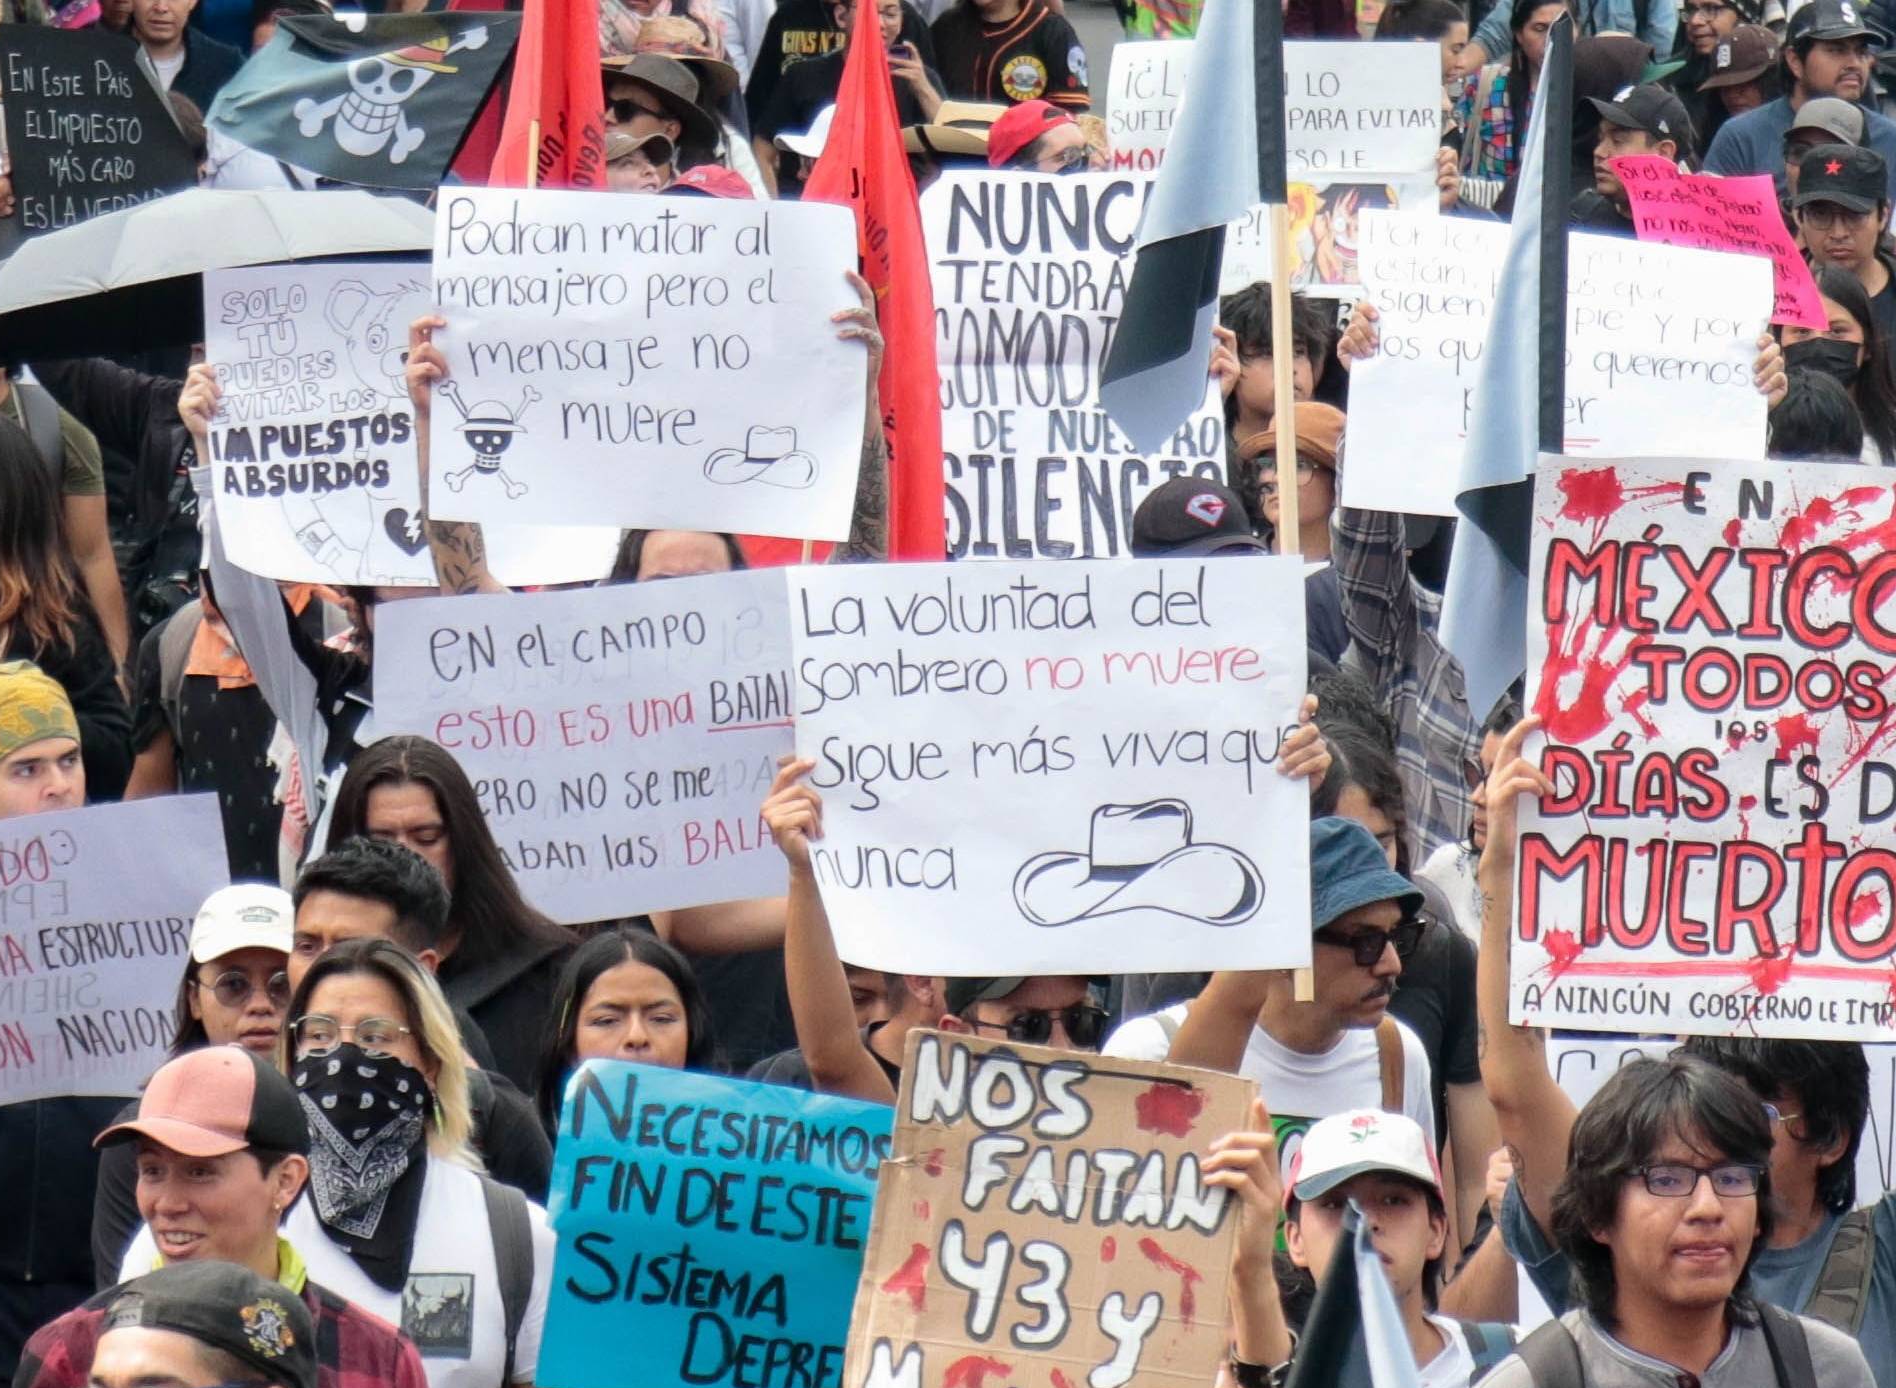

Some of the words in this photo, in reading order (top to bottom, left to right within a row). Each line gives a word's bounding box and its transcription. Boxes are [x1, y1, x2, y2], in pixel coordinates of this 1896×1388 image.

[8, 53, 35, 93] EN
[42, 66, 84, 97] ESTE
[1306, 71, 1340, 97] LO
[1289, 109, 1349, 131] PARA
[1357, 107, 1437, 130] EVITAR
[49, 148, 85, 187] MÁS
[91, 156, 135, 183] CARO
[23, 197, 47, 228] ES
[50, 194, 76, 228] LA
[447, 196, 586, 258] Podran
[603, 209, 716, 257] matar
[735, 212, 771, 256] al
[221, 284, 306, 324] SOLO
[436, 268, 628, 317] mensajero
[646, 272, 728, 318] pero
[748, 268, 780, 305] el
[214, 350, 337, 391] PUEDES
[468, 333, 664, 388] mensaje
[693, 333, 751, 371] no
[1594, 350, 1751, 390] queremos
[211, 381, 325, 425] EVITAR
[330, 388, 377, 413] LOS
[562, 401, 705, 447] muere
[211, 412, 410, 463] IMPUESTOS
[974, 410, 1016, 453] DE
[224, 459, 390, 498] ABSURDOS
[802, 586, 866, 638] La
[885, 575, 1097, 635] voluntad
[1131, 566, 1212, 628] del
[1025, 655, 1085, 690] no
[1104, 645, 1266, 687] muere
[1631, 644, 1888, 721] TODOS
[559, 704, 610, 748] ES
[972, 726, 1076, 780] más
[1102, 729, 1207, 768] viva
[561, 772, 608, 814] NO
[674, 765, 715, 800] me
[1538, 731, 1731, 824] DÍAS
[1764, 754, 1830, 820] ES
[602, 833, 660, 872] las
[813, 845, 957, 891] nunca
[1522, 983, 1544, 1012] A
[1555, 982, 1672, 1018] NINGÚN
[1688, 989, 1813, 1022] GOBIERNO
[1819, 998, 1838, 1022] LE
[910, 1032, 1092, 1139] NOS
[570, 1065, 894, 1180] NECESITAMOS
[570, 1155, 667, 1216] FIN
[677, 1168, 740, 1232] DE
[750, 1175, 863, 1252] ESTE
[938, 1219, 1072, 1349] 43
